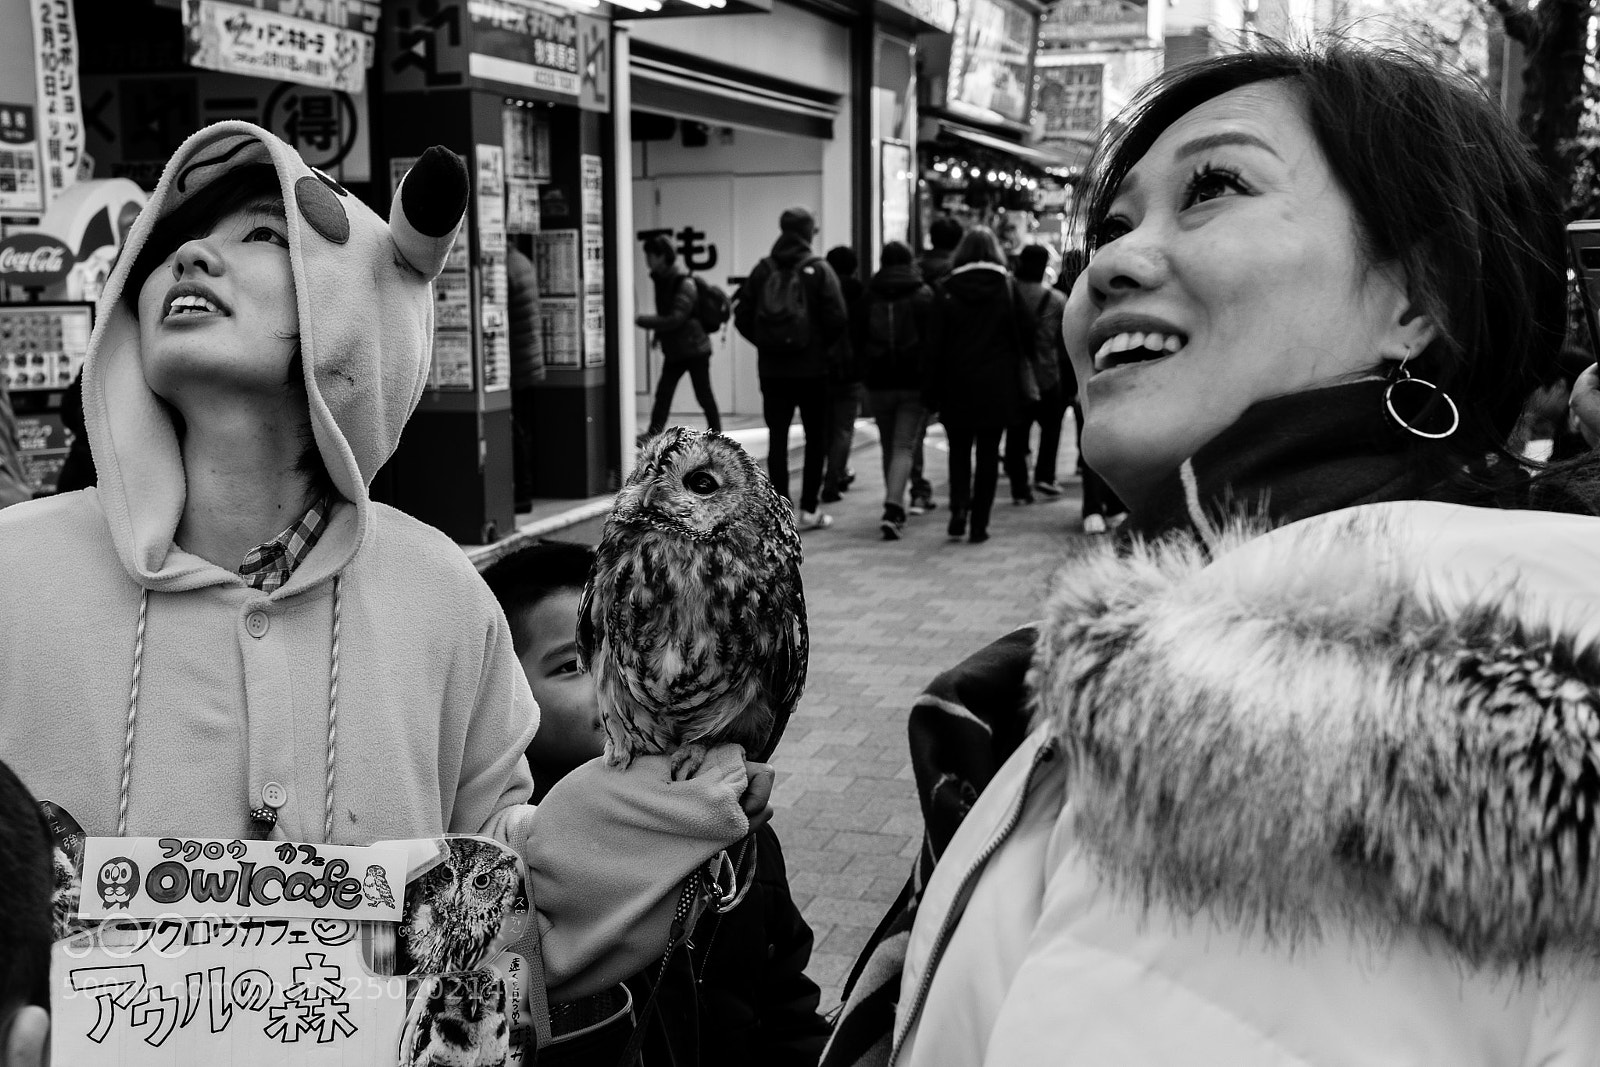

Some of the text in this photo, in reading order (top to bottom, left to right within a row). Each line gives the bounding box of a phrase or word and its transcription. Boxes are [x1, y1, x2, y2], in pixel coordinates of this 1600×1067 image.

[158, 838, 248, 863] フクロウ
[274, 842, 326, 867] カフェ
[115, 916, 310, 954] フクロウカフェ
[69, 952, 359, 1048] アウルの森
